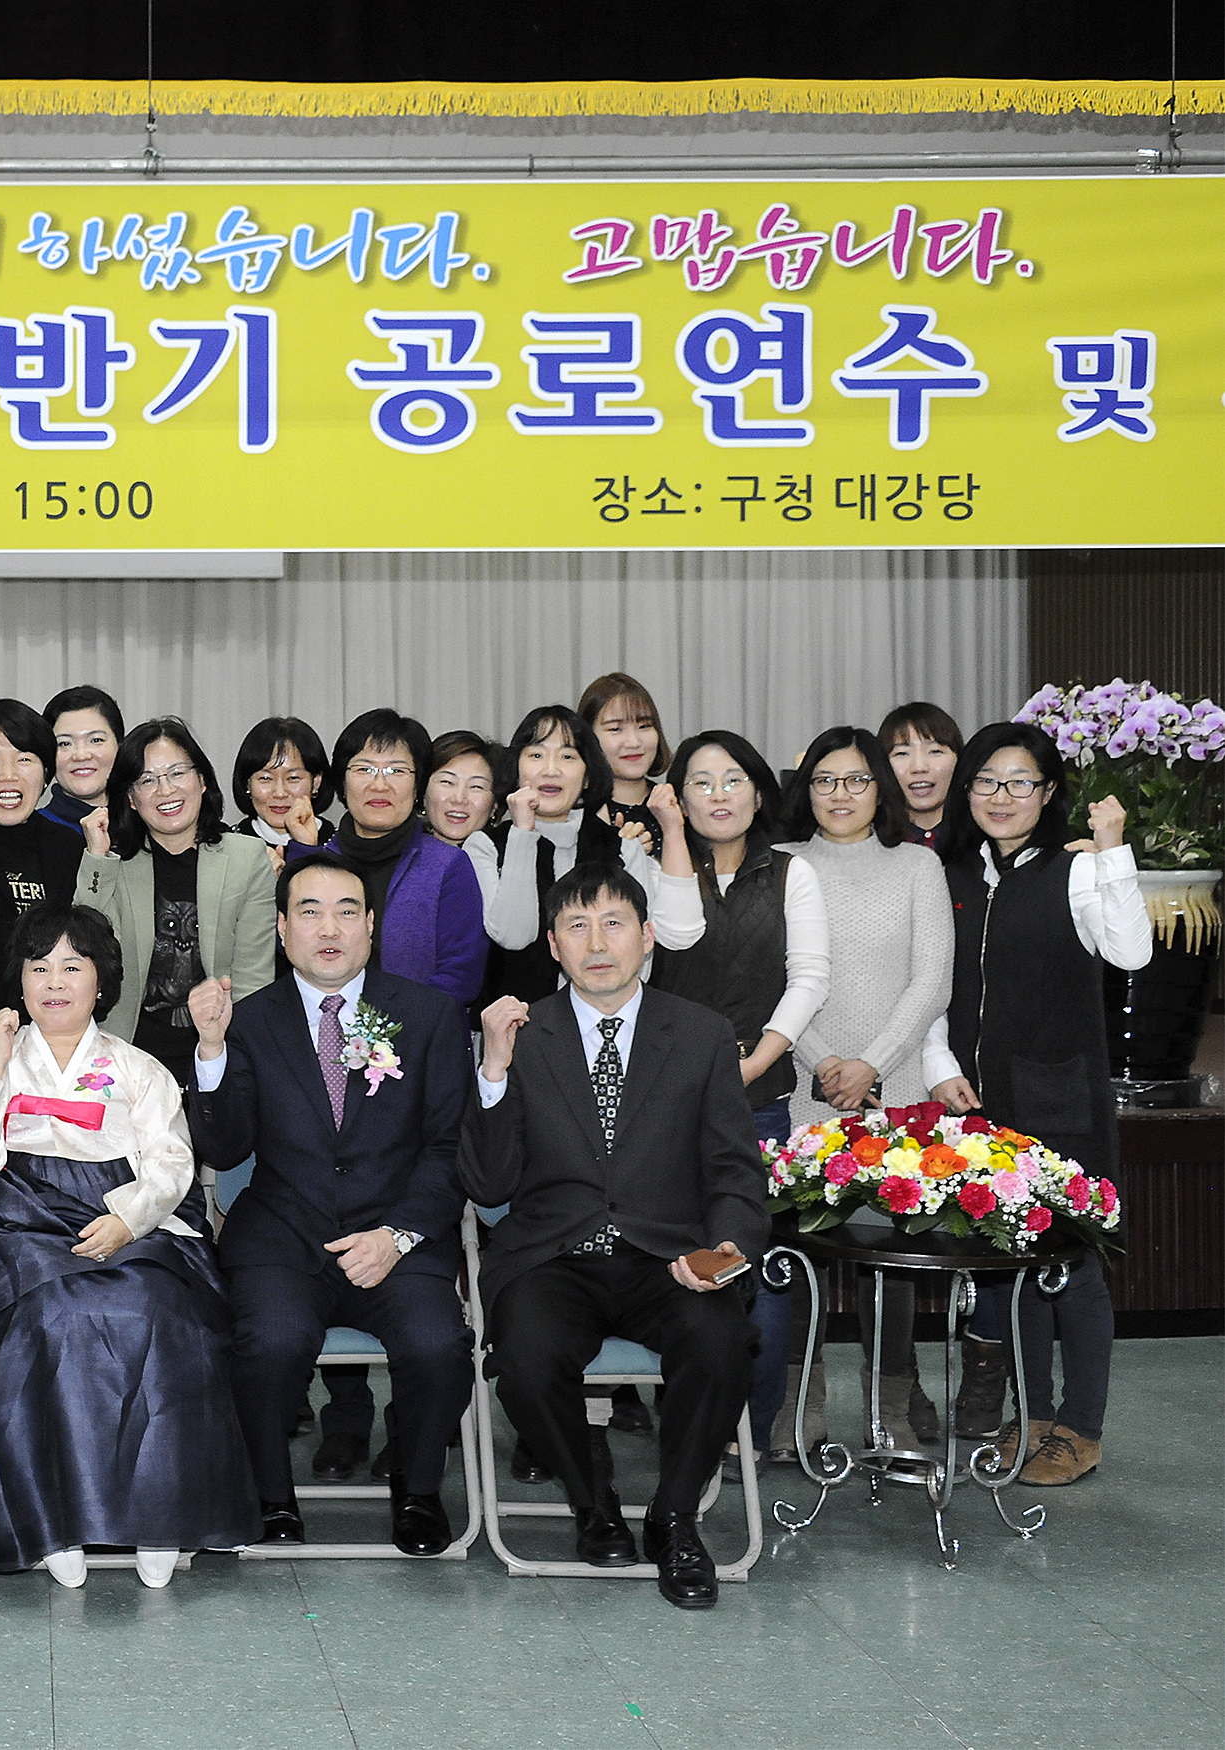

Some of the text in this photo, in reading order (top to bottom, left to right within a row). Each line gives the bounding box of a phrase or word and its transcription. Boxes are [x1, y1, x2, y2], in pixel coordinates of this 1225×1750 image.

[17, 205, 491, 294] 하셨습니다.
[562, 203, 1034, 291] 고맙습니다.
[347, 302, 988, 454] 공로연수
[1046, 328, 1157, 443] 및
[15, 480, 154, 521] 15:00
[592, 472, 981, 523] 장소: 구청 대강당
